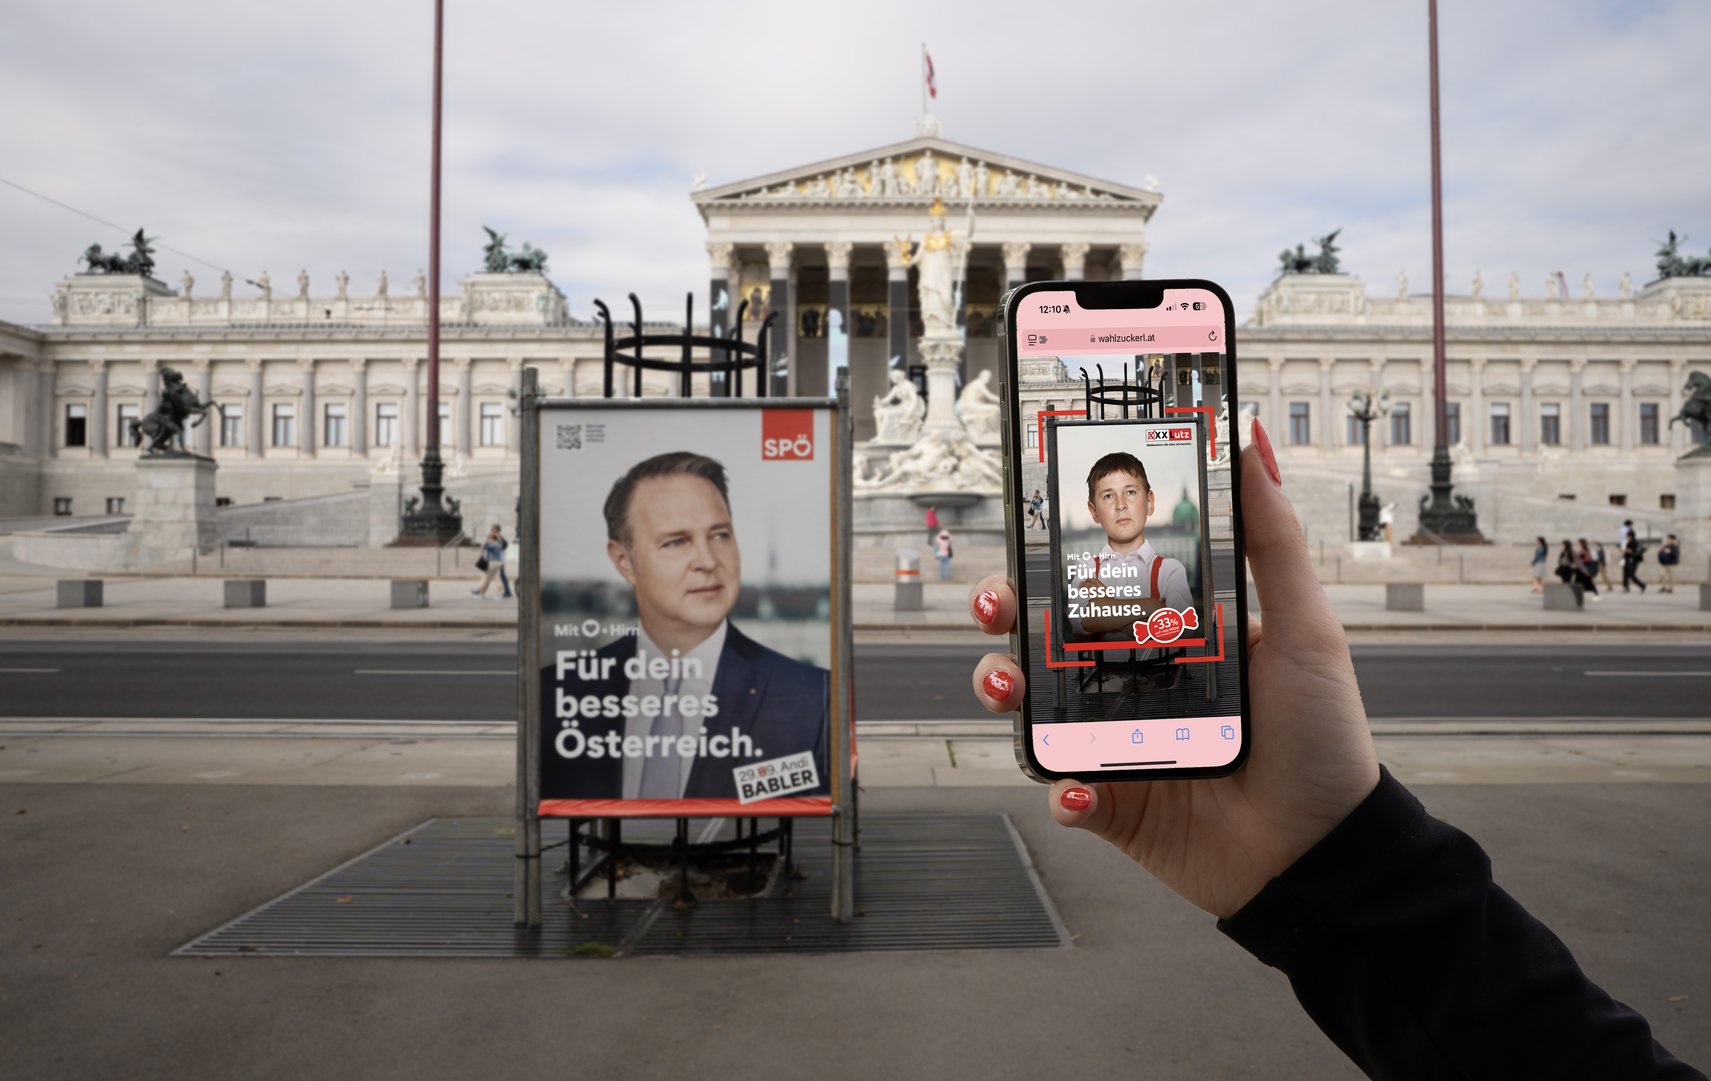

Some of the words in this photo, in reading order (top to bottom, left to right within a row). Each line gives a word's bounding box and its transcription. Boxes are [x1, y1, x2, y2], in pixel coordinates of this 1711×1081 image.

[1039, 305, 1061, 314] 12:10
[1098, 333, 1155, 343] wahlzuckerl.at
[764, 434, 811, 457] SPÖ
[1067, 553, 1080, 561] Mit
[1098, 552, 1116, 560] Hirn
[1067, 564, 1096, 580] Für
[1100, 563, 1138, 579] dein
[1067, 584, 1141, 599] besseres
[1068, 602, 1147, 619] Zuhause.
[554, 624, 579, 637] Mit
[1153, 617, 1179, 630] -33%
[556, 650, 616, 680] Für
[623, 649, 703, 680] dein
[556, 687, 719, 718] besseres
[554, 719, 763, 759] Österreich.
[781, 756, 809, 772] Andi
[742, 769, 814, 799] BABLER
